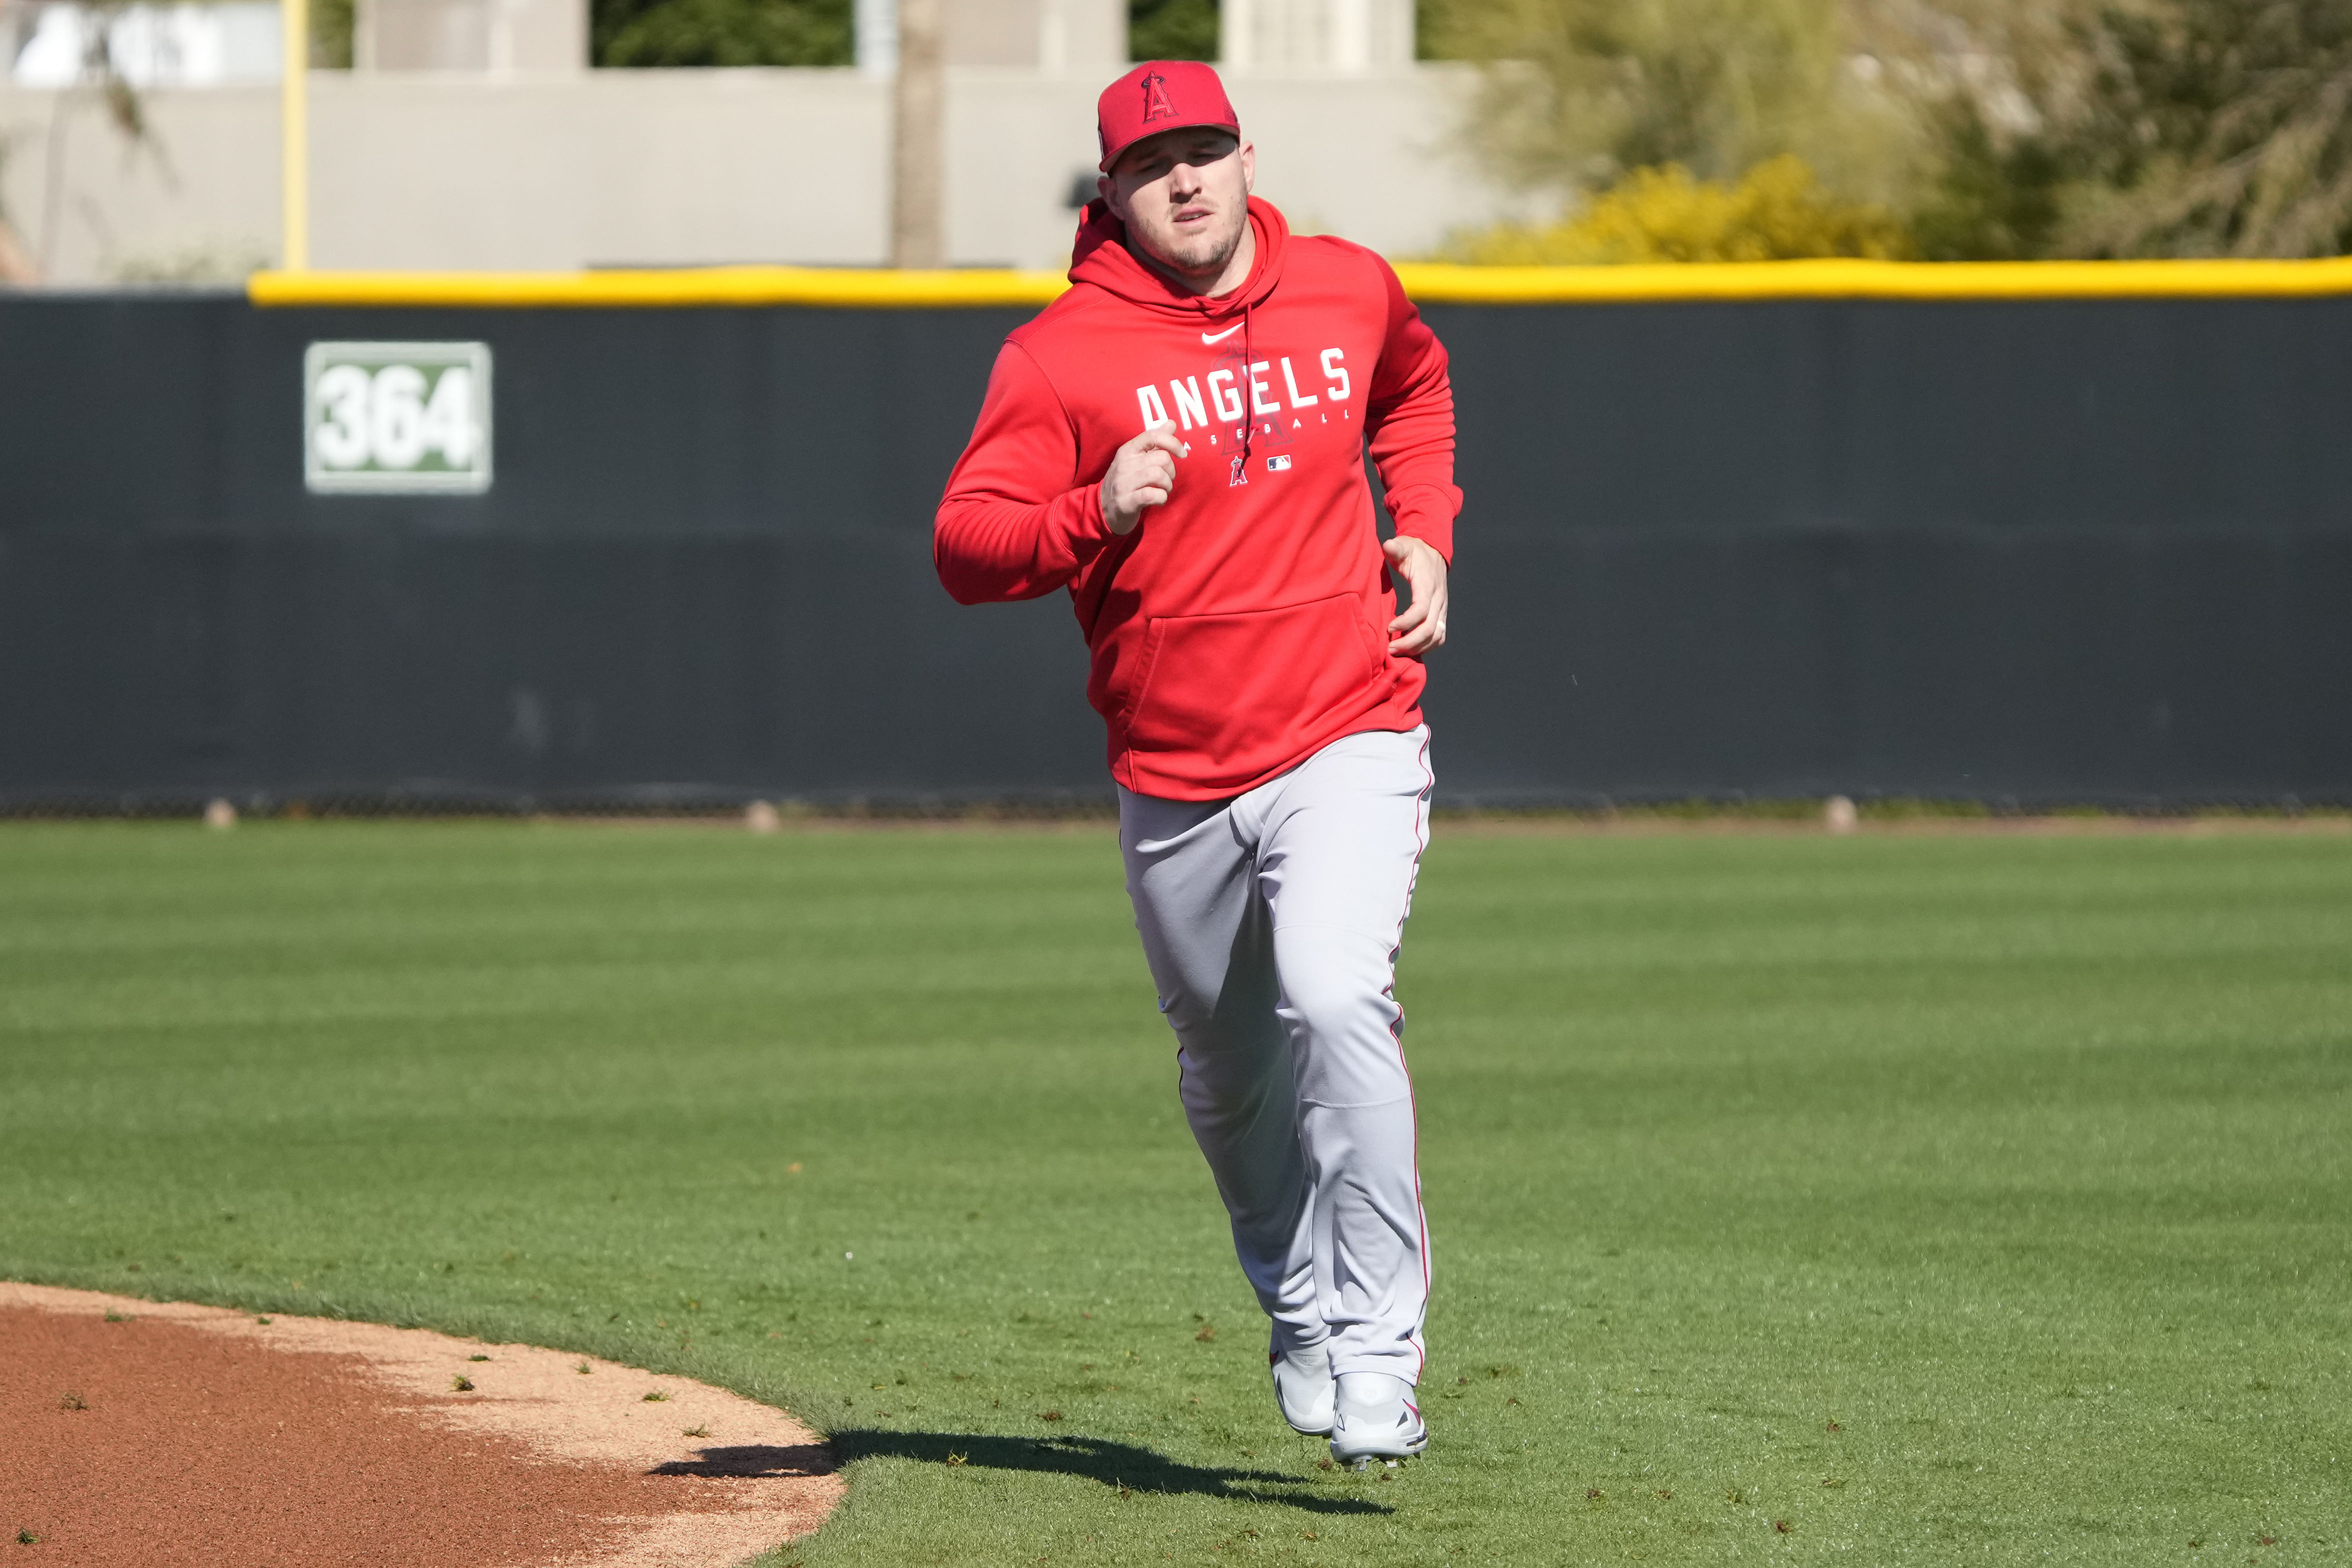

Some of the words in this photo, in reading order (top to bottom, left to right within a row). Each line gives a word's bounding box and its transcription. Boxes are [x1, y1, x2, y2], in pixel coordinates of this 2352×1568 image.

[1141, 70, 1179, 123] A
[315, 364, 484, 469] 364
[1136, 348, 1350, 430] ANGELS
[1184, 409, 1349, 450] ASEBALL
